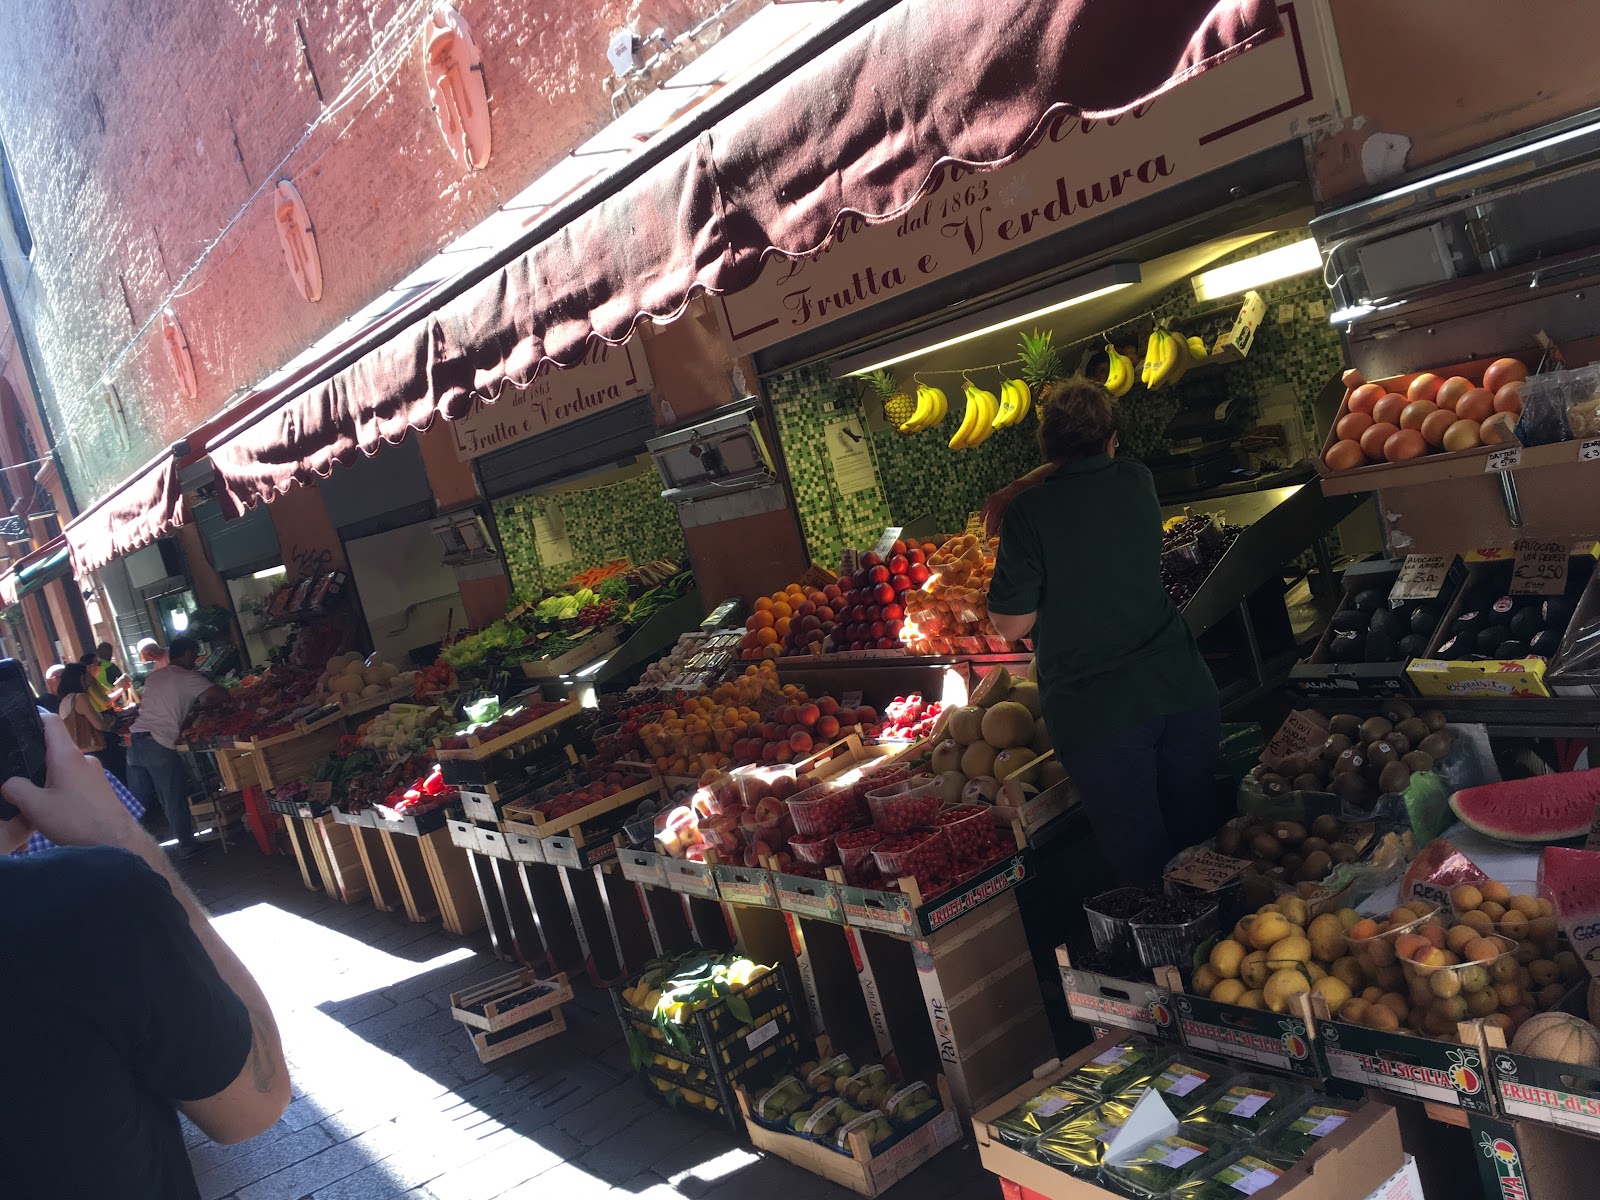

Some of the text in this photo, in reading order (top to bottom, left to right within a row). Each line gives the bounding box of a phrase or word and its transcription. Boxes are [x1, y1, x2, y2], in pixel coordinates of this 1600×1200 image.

[896, 209, 931, 238] dal
[939, 179, 989, 219] 1863
[782, 265, 906, 326] Frutta
[917, 253, 938, 274] e
[940, 154, 1176, 256] Verdura
[512, 381, 551, 408] dal 1863
[464, 382, 622, 453] Frutta e Verdura
[1407, 556, 1443, 564] AVOCADO
[1519, 540, 1566, 553] AVOCADO
[1523, 553, 1537, 561] VIA
[1282, 726, 1307, 745] NUOVA
[1288, 716, 1313, 735] KIWI
[930, 874, 1010, 927] FRUTTI di SICILIA
[1068, 992, 1151, 1021] FRUTTI di SICILIA
[931, 997, 958, 1064] Pavone
[1183, 1021, 1283, 1052] FRUTTI di SICILIA
[1377, 1060, 1393, 1075] di
[1395, 1062, 1452, 1087] SICILIA
[1502, 1083, 1560, 1107] FRUTTI
[1564, 1096, 1582, 1112] di
